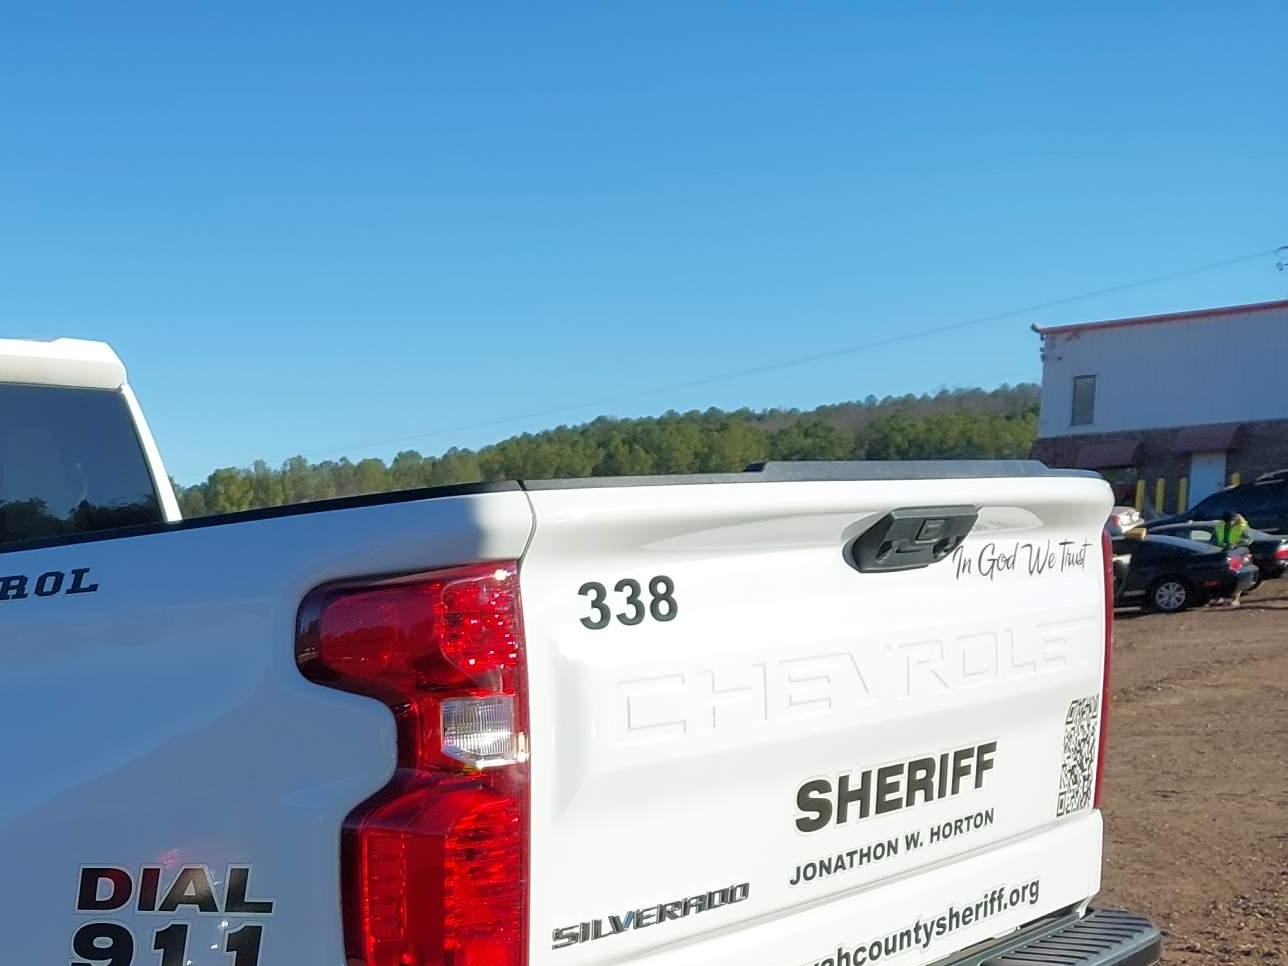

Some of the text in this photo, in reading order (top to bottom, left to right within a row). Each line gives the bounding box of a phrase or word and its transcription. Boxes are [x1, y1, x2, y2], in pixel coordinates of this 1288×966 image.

[952, 538, 1094, 581] In God We Trust
[578, 575, 679, 630] 338
[794, 740, 998, 833] SHERIFF
[789, 807, 995, 886] JONATHON W. HORTON
[76, 867, 274, 914] DIAL
[551, 882, 751, 951] SILVERADO
